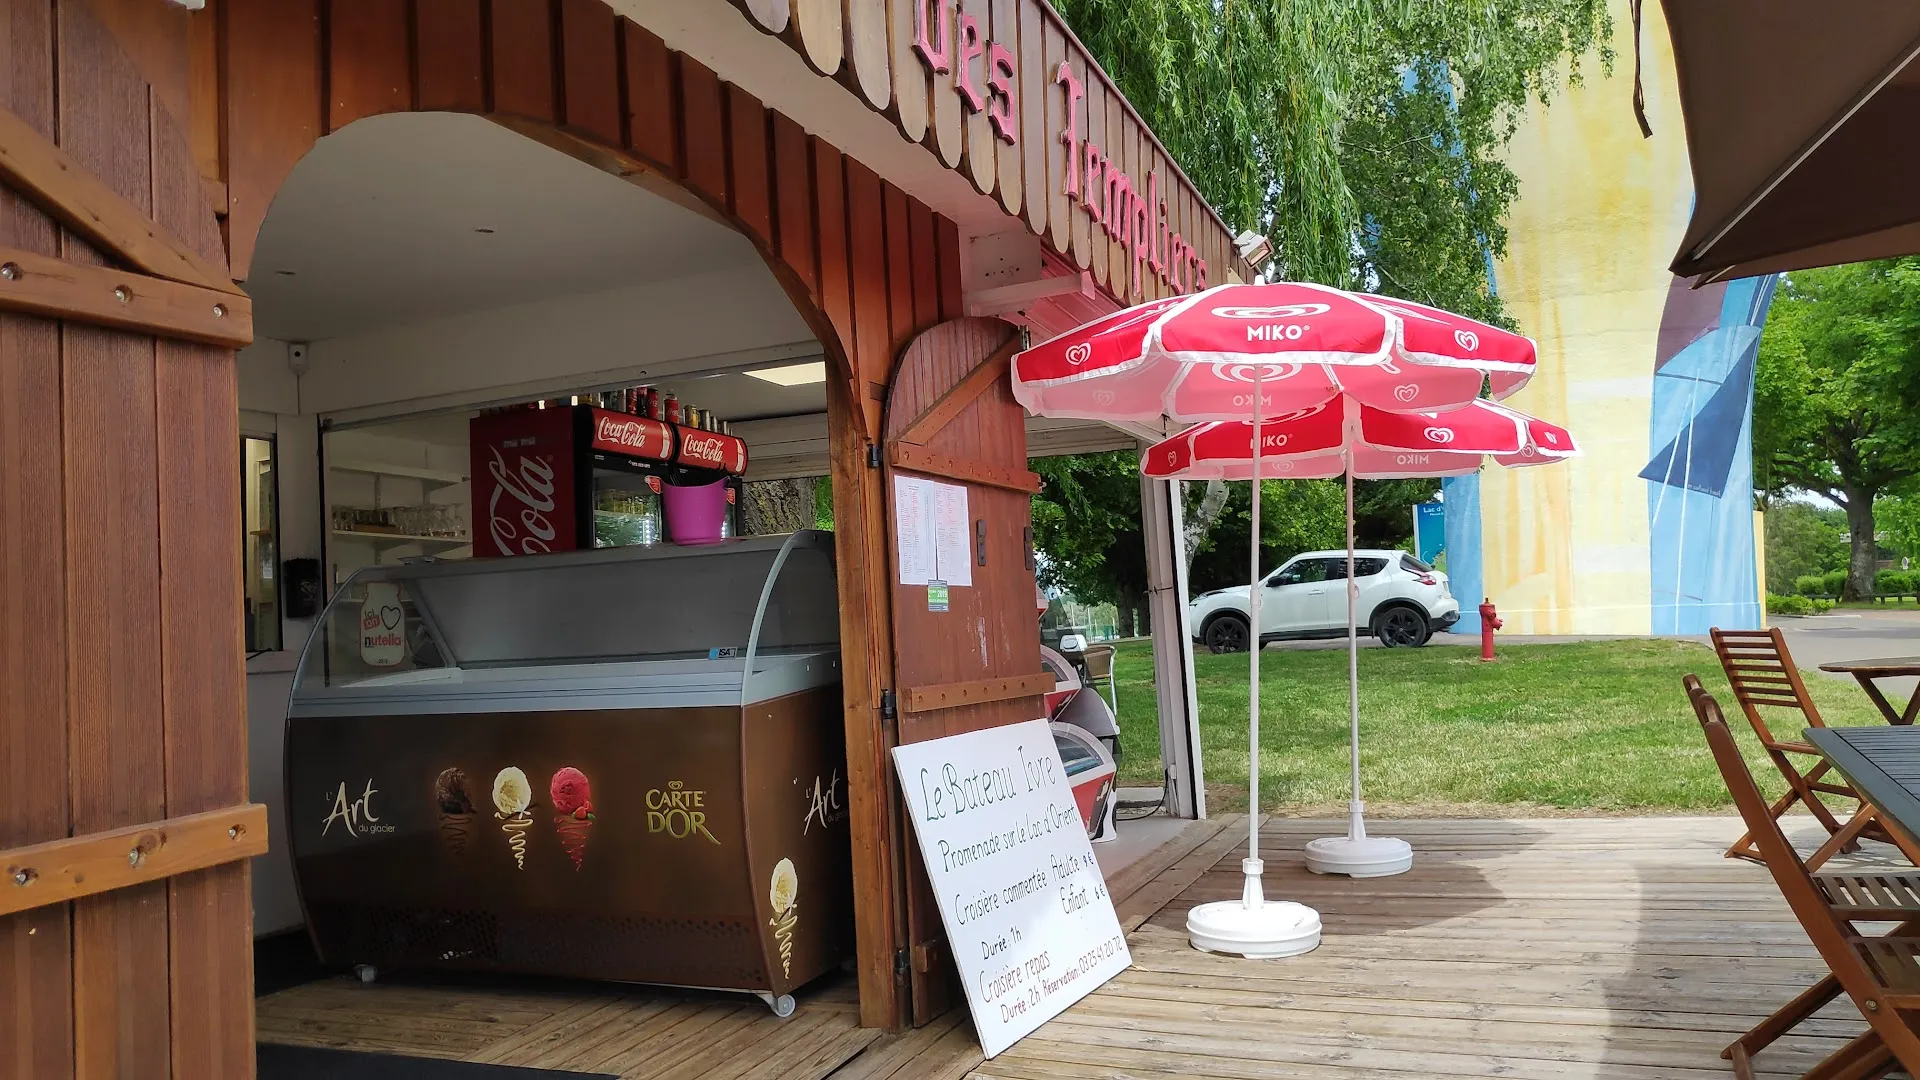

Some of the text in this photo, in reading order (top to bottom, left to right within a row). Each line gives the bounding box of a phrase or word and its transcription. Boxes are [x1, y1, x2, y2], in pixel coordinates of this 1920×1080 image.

[1247, 324, 1303, 342] MIKO
[597, 416, 646, 448] Coca-Cola
[683, 433, 724, 463] Coca-Cola
[364, 632, 401, 647] nutella
[920, 745, 1056, 822] Le Bateau Ivre
[645, 789, 705, 811] CARTE
[358, 823, 396, 835] du glacier
[646, 807, 721, 845] D'OR
[937, 832, 1001, 873] Promenade
[1002, 830, 1016, 850] sur
[1043, 803, 1078, 834] d'Orient
[954, 889, 1000, 926] Croisière
[1002, 867, 1048, 905] commentée
[1050, 853, 1080, 882] Adulte
[1059, 883, 1089, 915] Enfant
[979, 950, 1051, 1003] Croisière repas
